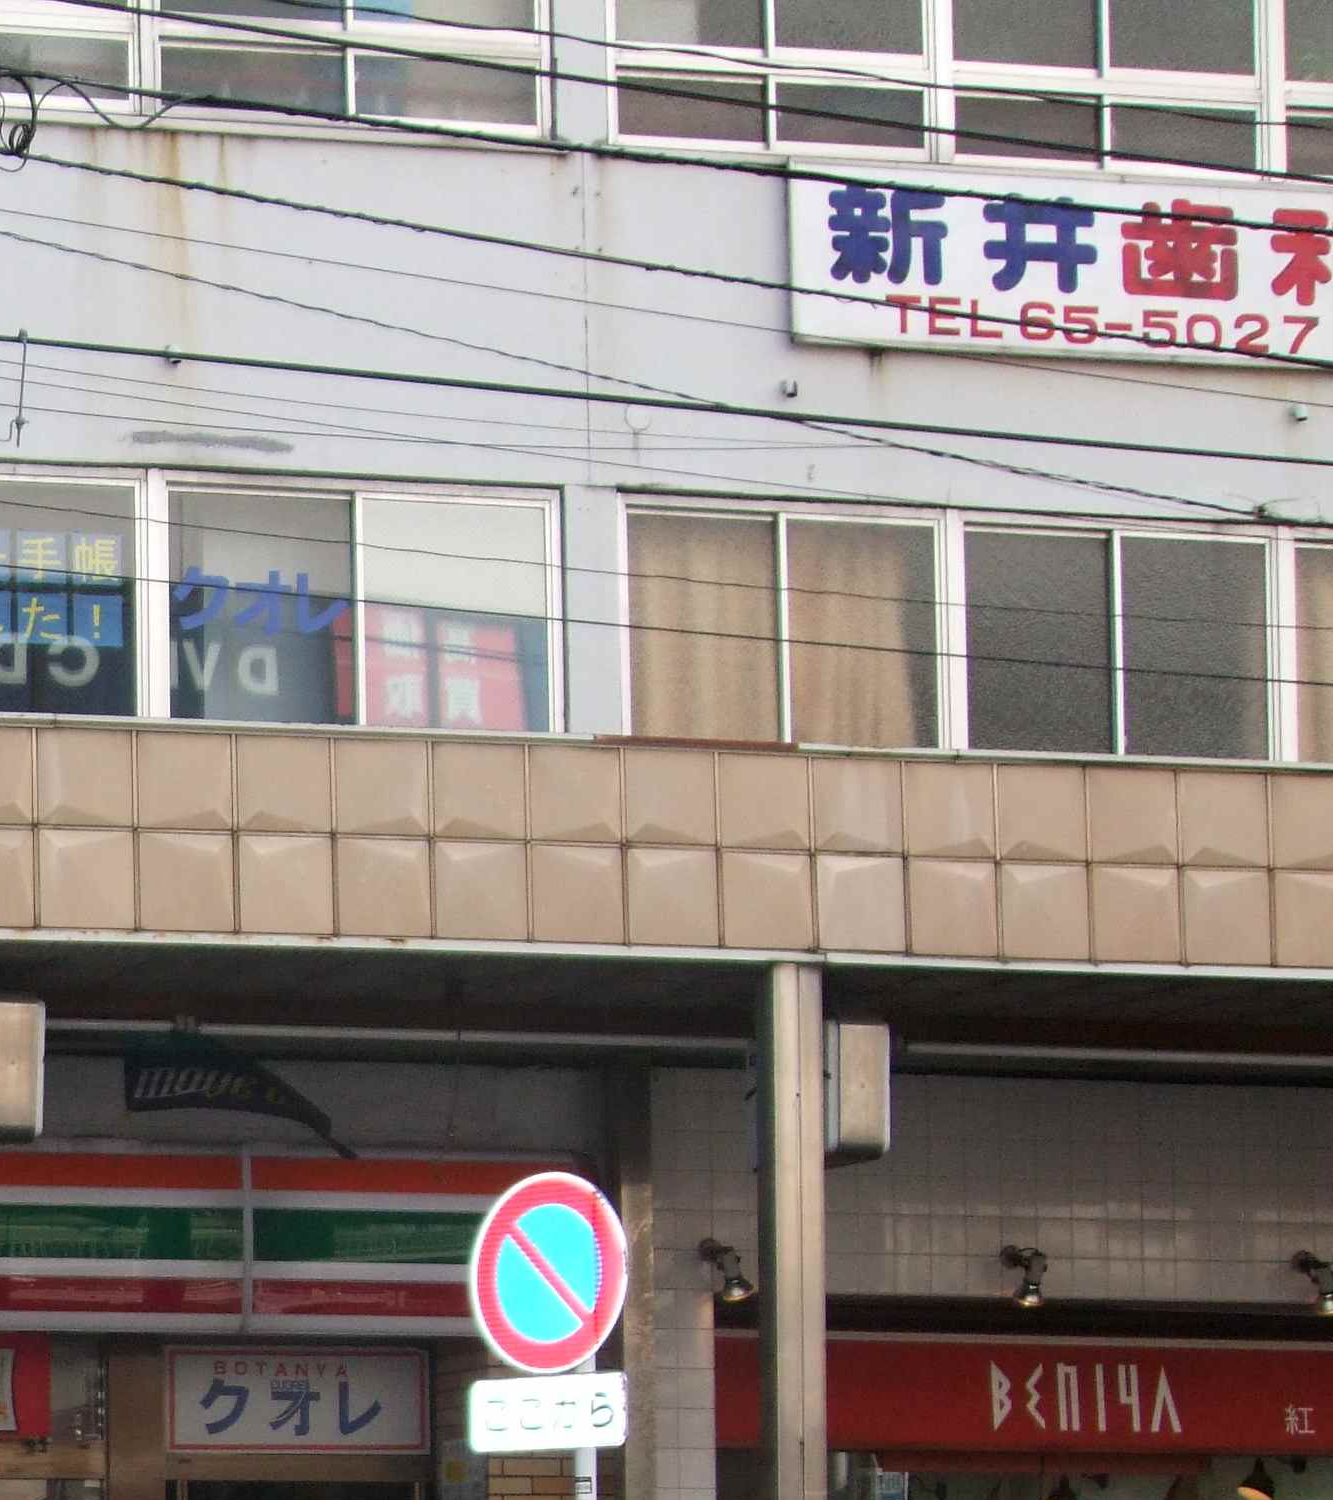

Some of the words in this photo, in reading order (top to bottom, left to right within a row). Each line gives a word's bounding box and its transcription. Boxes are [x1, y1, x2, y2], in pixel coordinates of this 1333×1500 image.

[886, 294, 1004, 341] TEL
[1019, 300, 1321, 356] 65-5027
[173, 565, 351, 636] クオレ
[198, 1377, 383, 1436] クオレ
